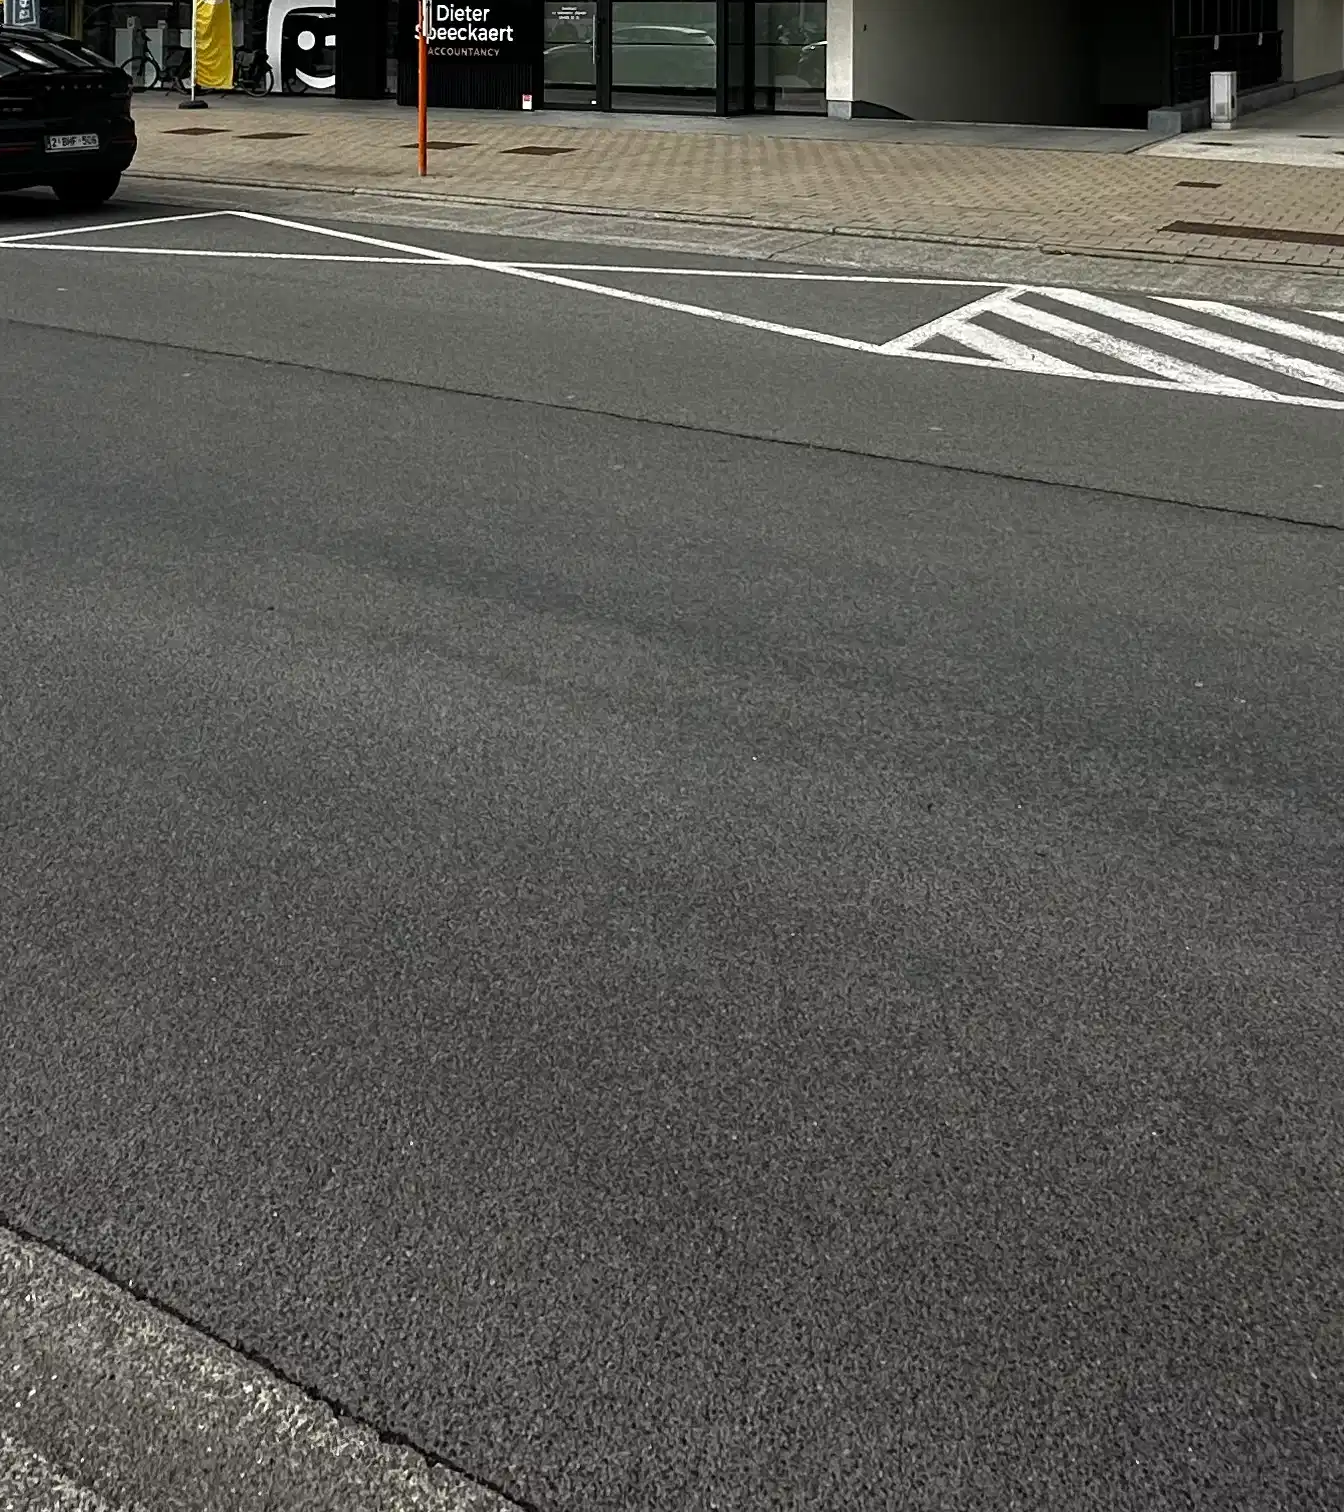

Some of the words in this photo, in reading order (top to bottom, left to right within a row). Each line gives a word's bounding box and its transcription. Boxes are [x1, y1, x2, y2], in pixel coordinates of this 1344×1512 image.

[436, 4, 490, 22] Dieter
[414, 23, 514, 45] Speeckaert
[427, 46, 500, 57] ACCOUNTANCY
